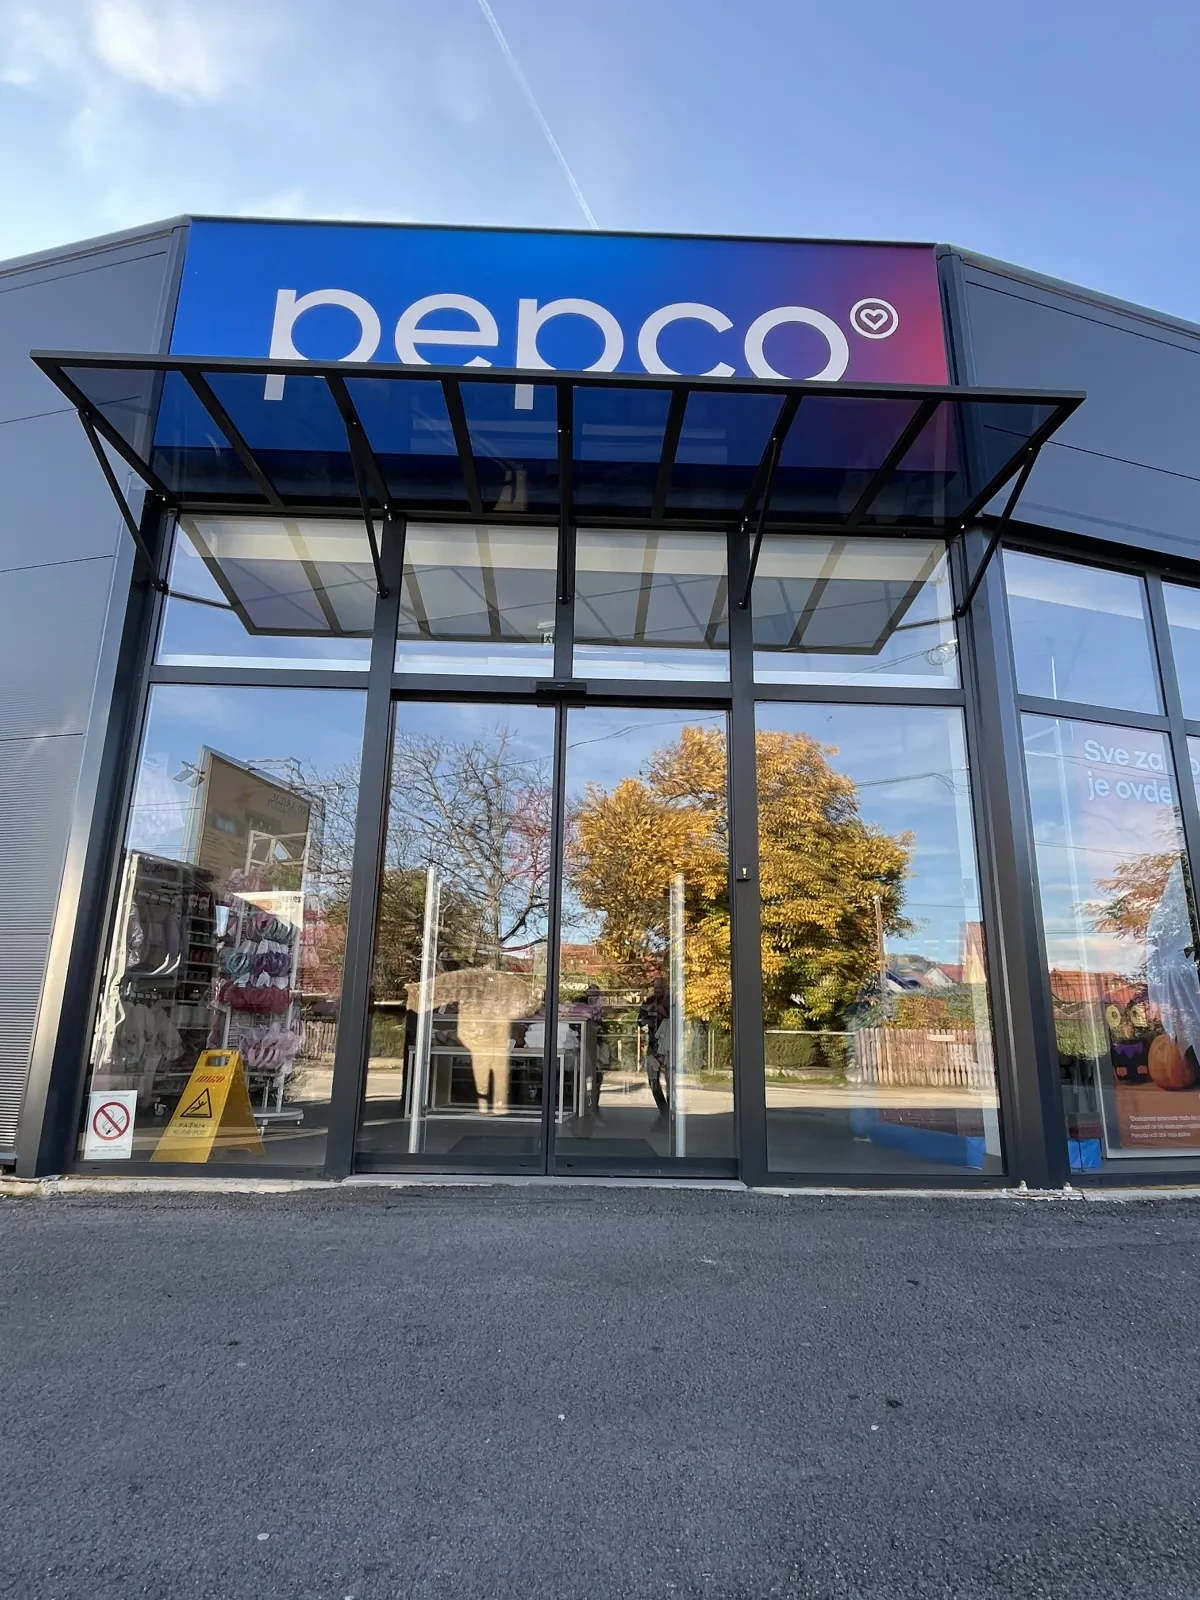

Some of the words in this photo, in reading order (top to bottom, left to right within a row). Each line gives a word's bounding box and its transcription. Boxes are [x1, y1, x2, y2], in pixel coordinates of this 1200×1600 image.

[263, 288, 850, 410] pepco
[1084, 739, 1130, 767] Sve
[1134, 750, 1164, 771] za
[1087, 770, 1110, 801] je
[1115, 779, 1173, 804] ovde
